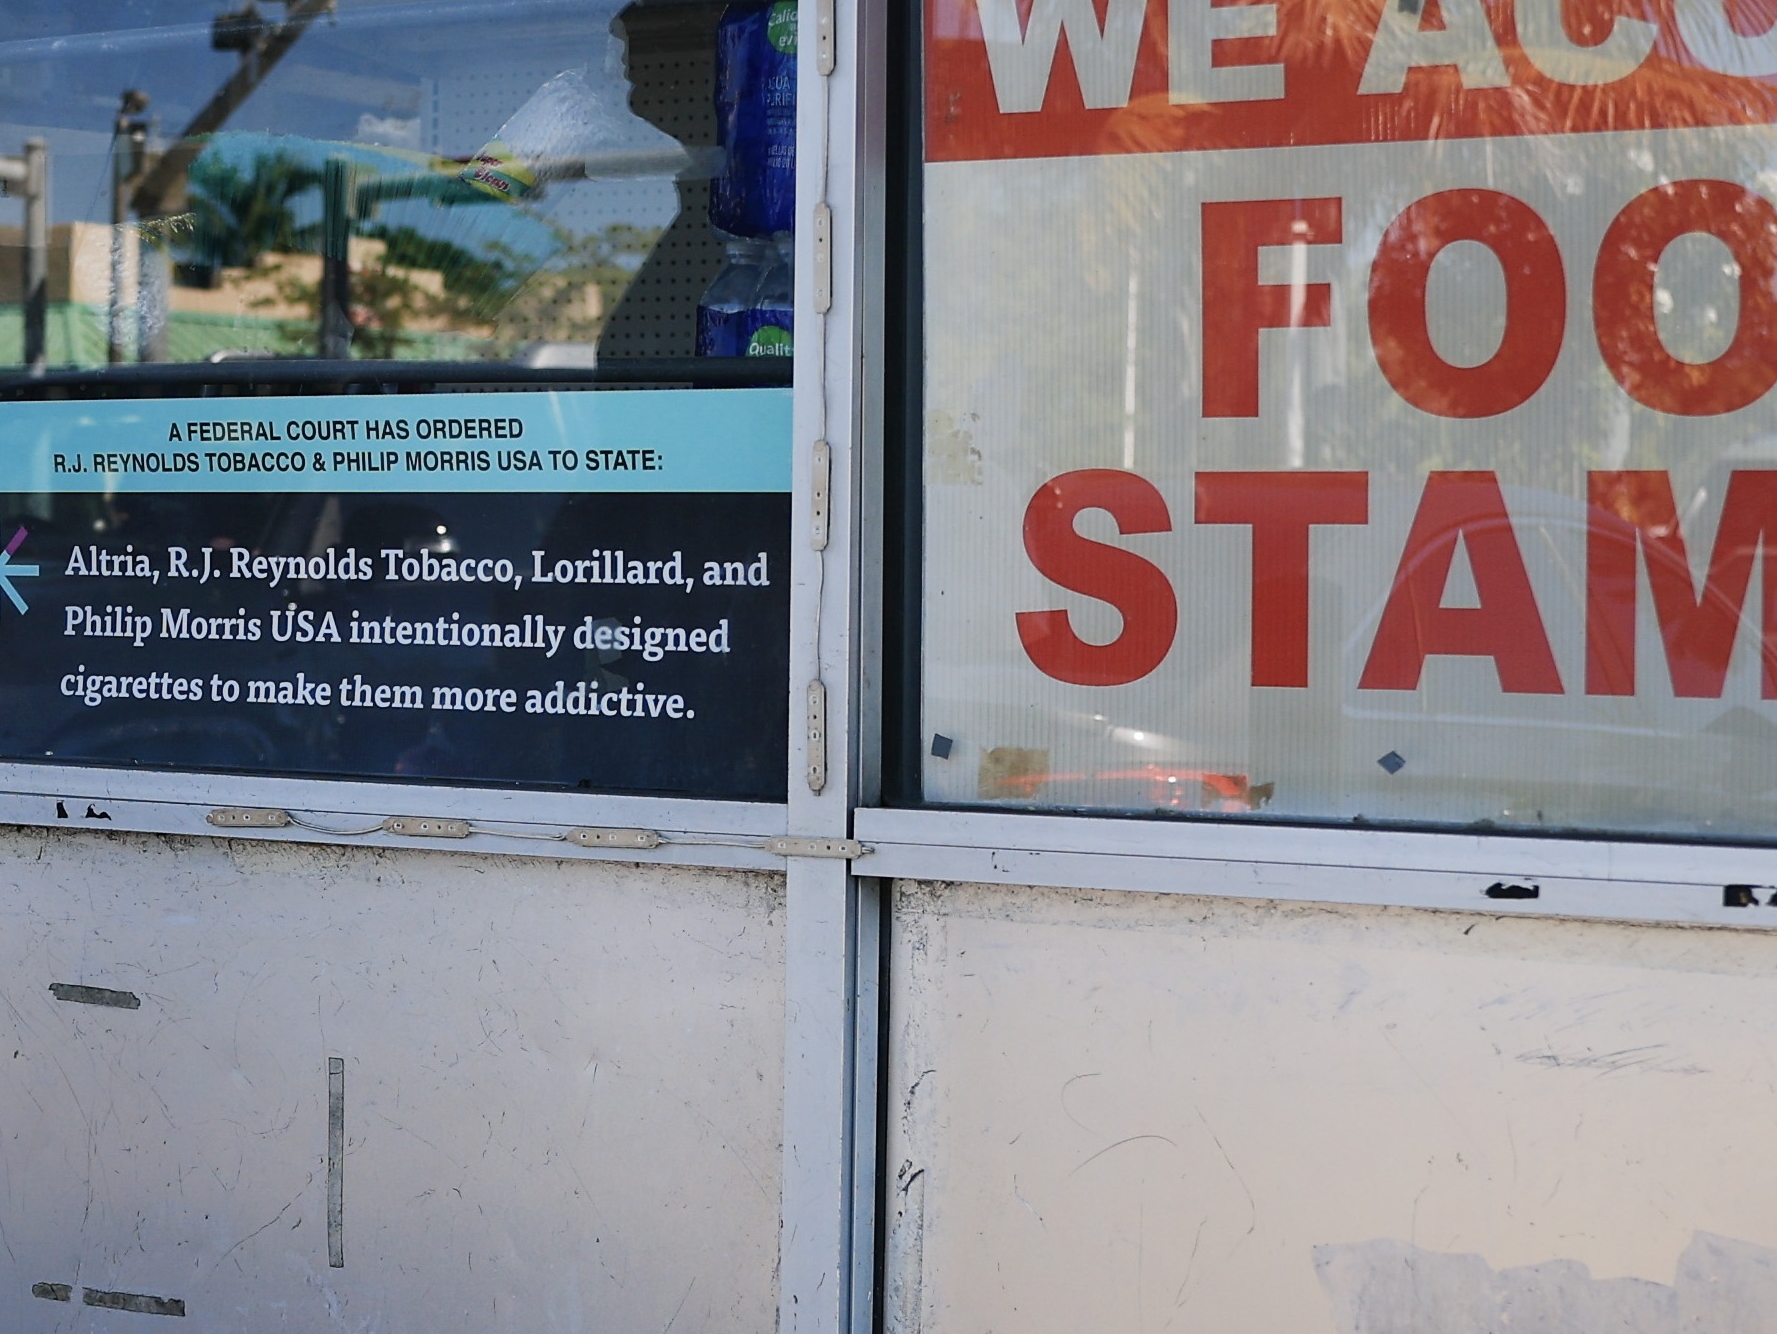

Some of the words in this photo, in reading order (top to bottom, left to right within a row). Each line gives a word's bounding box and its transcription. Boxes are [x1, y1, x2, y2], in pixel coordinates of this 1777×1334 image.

[748, 332, 794, 357] Qualit
[169, 420, 182, 441] A
[186, 419, 282, 442] FEDERAL
[286, 419, 361, 442] COURT
[365, 418, 411, 441] HAS
[414, 417, 524, 440] ORDERED
[54, 452, 88, 474] R.J.
[93, 451, 199, 474] REYNOLDS
[203, 451, 307, 473] TOBACCO
[312, 451, 328, 473] &
[333, 450, 400, 472] PHILIP
[405, 450, 491, 472] MORRIS
[496, 449, 544, 471] USA
[547, 449, 580, 471] TO
[585, 448, 665, 472] STATE:
[65, 545, 161, 584] Altria,
[167, 548, 222, 585] R.J.
[229, 547, 373, 591] Reynolds
[379, 548, 523, 590] Tobacco,
[531, 548, 695, 593] Lorillard,
[701, 552, 770, 588] and
[64, 605, 153, 648] Philip
[159, 606, 262, 643] Morris
[270, 610, 341, 645] USA
[349, 610, 566, 659] intentionally
[573, 615, 731, 662] designed
[60, 670, 203, 711] cigarettes
[209, 673, 241, 704] to
[247, 674, 332, 708] make
[339, 675, 423, 710] them
[430, 686, 517, 714] more
[524, 679, 696, 720] addictive.
